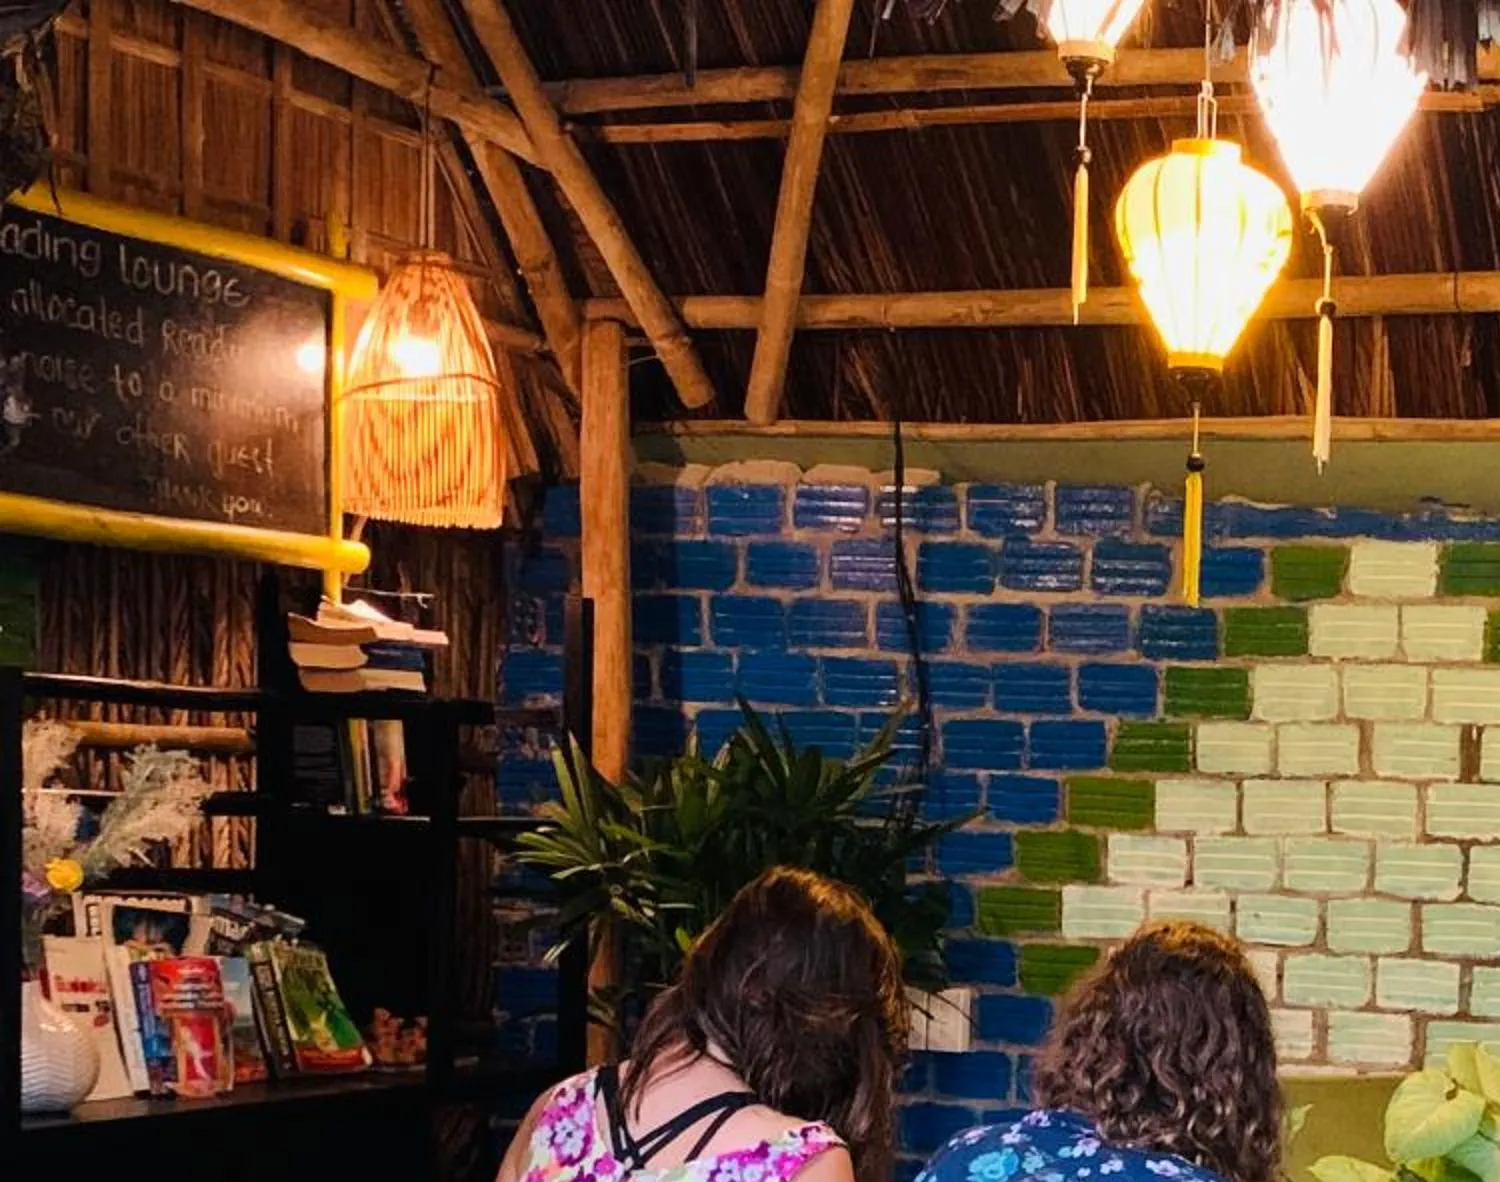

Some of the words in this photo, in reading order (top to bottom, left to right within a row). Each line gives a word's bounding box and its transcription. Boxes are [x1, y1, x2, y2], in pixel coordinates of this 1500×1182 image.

[119, 243, 252, 307] lounge
[11, 278, 145, 348] allocated
[110, 364, 142, 403] to
